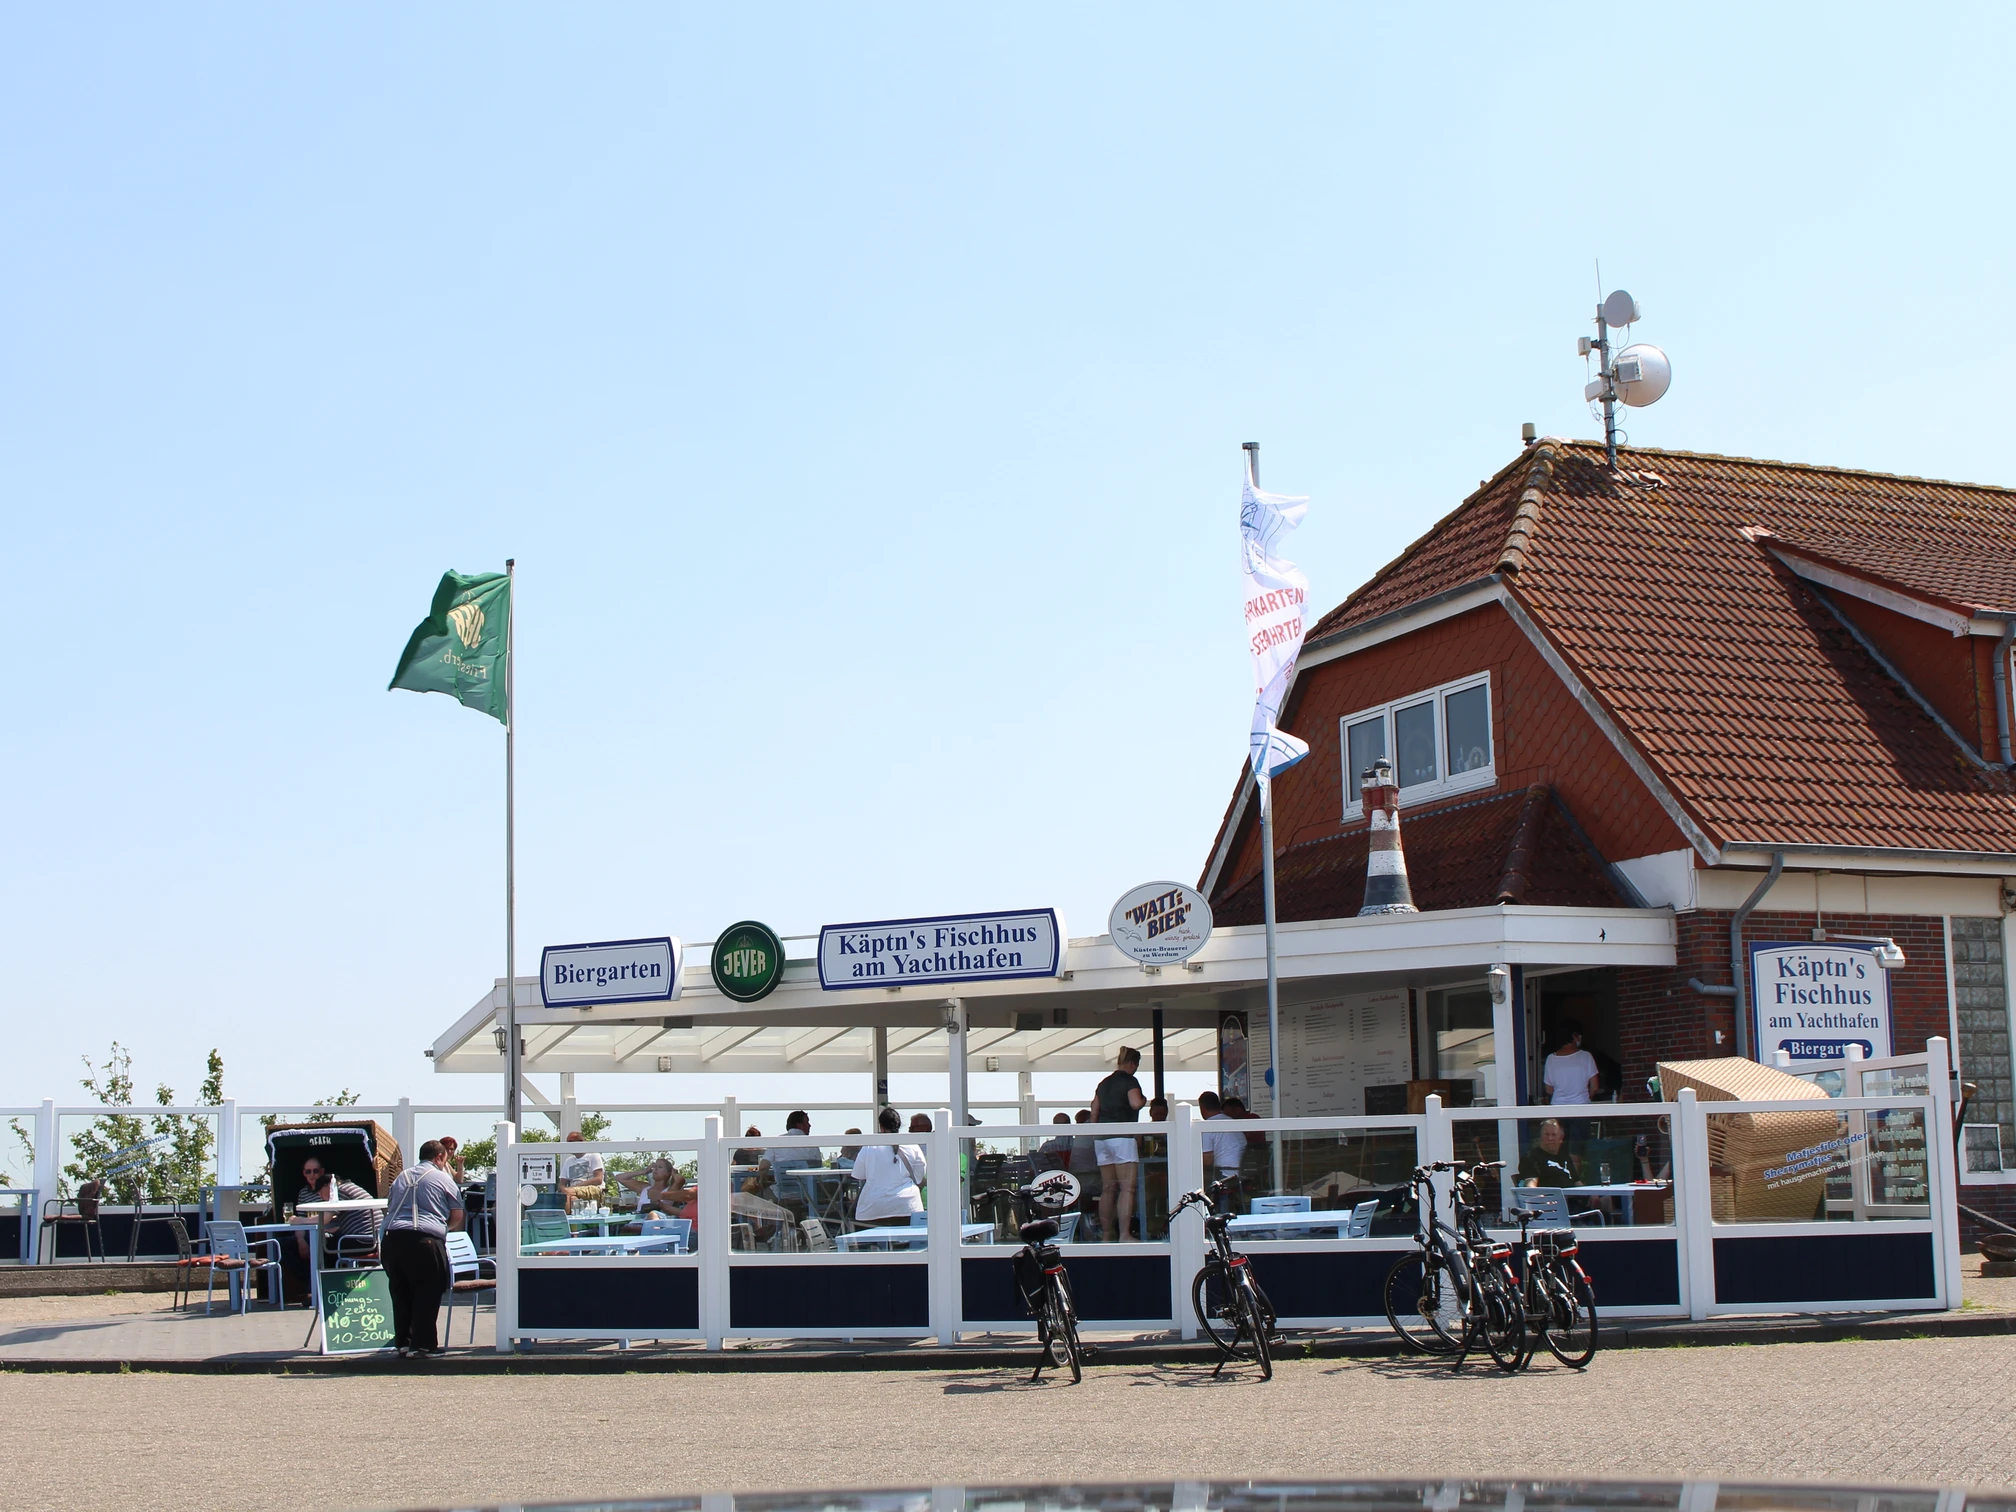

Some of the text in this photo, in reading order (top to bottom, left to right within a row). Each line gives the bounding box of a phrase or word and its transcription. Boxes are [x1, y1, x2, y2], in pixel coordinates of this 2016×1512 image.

[838, 924, 1037, 958] Käptn's Fischhus
[1133, 945, 1188, 953] Küsten-Brauerei
[554, 961, 661, 987] Biergarten
[724, 949, 766, 978] JEVER
[852, 949, 1023, 977] am Yachthafen
[1776, 956, 1865, 982] Käptn's
[1774, 983, 1872, 1005] Fischhus
[1769, 1012, 1879, 1029] am Yachthafen
[1791, 1042, 1846, 1058] Biergart
[1786, 1139, 1842, 1163] Matjesfilet
[1843, 1131, 1868, 1146] oder
[1764, 1153, 1833, 1180] Sherrymatjes
[1767, 1180, 1780, 1190] mit
[1780, 1164, 1836, 1187] hausgemachten
